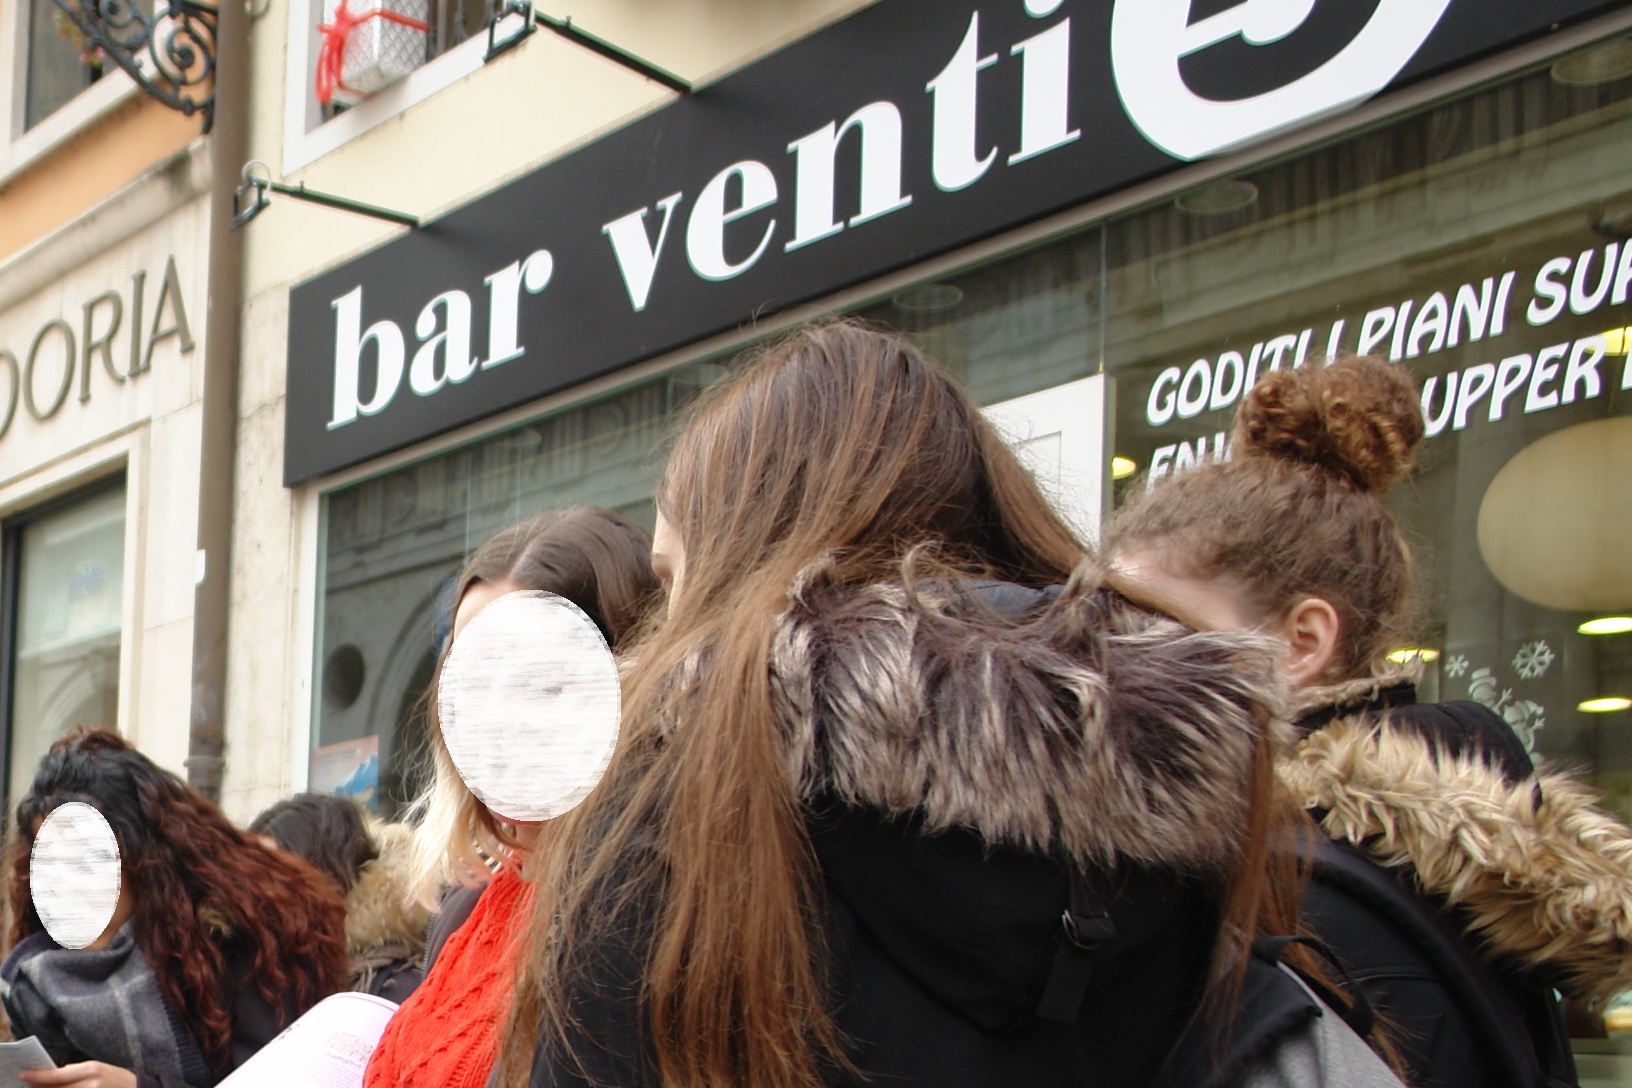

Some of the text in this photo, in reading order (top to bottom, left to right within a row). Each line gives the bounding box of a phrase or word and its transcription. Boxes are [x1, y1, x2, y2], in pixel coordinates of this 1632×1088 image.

[325, 249, 555, 432] bar
[601, 0, 1082, 312] venti
[1146, 328, 1313, 427] GODITI
[1355, 270, 1516, 363] PIANI
[1420, 333, 1609, 439] UPPER
